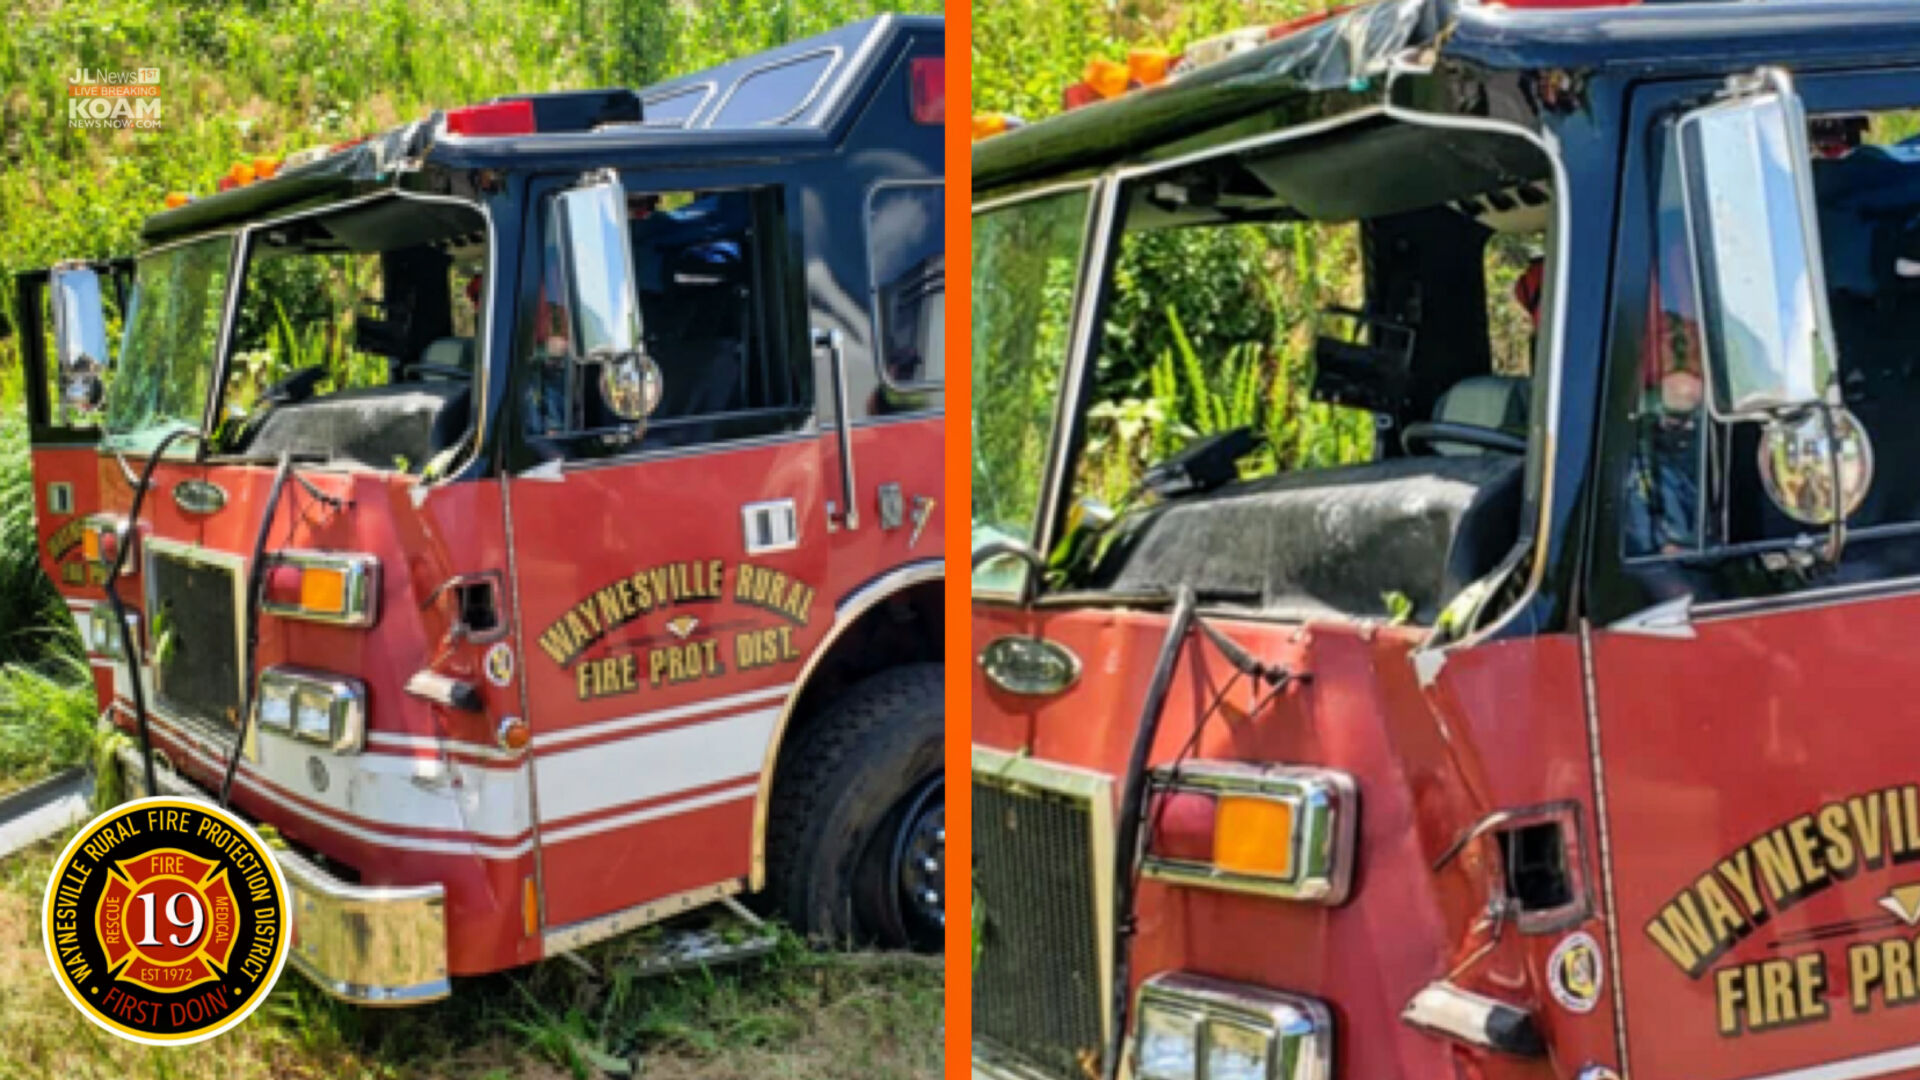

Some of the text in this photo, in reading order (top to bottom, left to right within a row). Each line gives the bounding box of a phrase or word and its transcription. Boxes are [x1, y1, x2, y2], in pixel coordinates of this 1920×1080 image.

[537, 560, 723, 667] WAYNESVILLE
[734, 562, 816, 626] RURAL
[576, 625, 800, 702] FIRE PROT. DIST.
[1716, 932, 1920, 1038] FIRE PR
